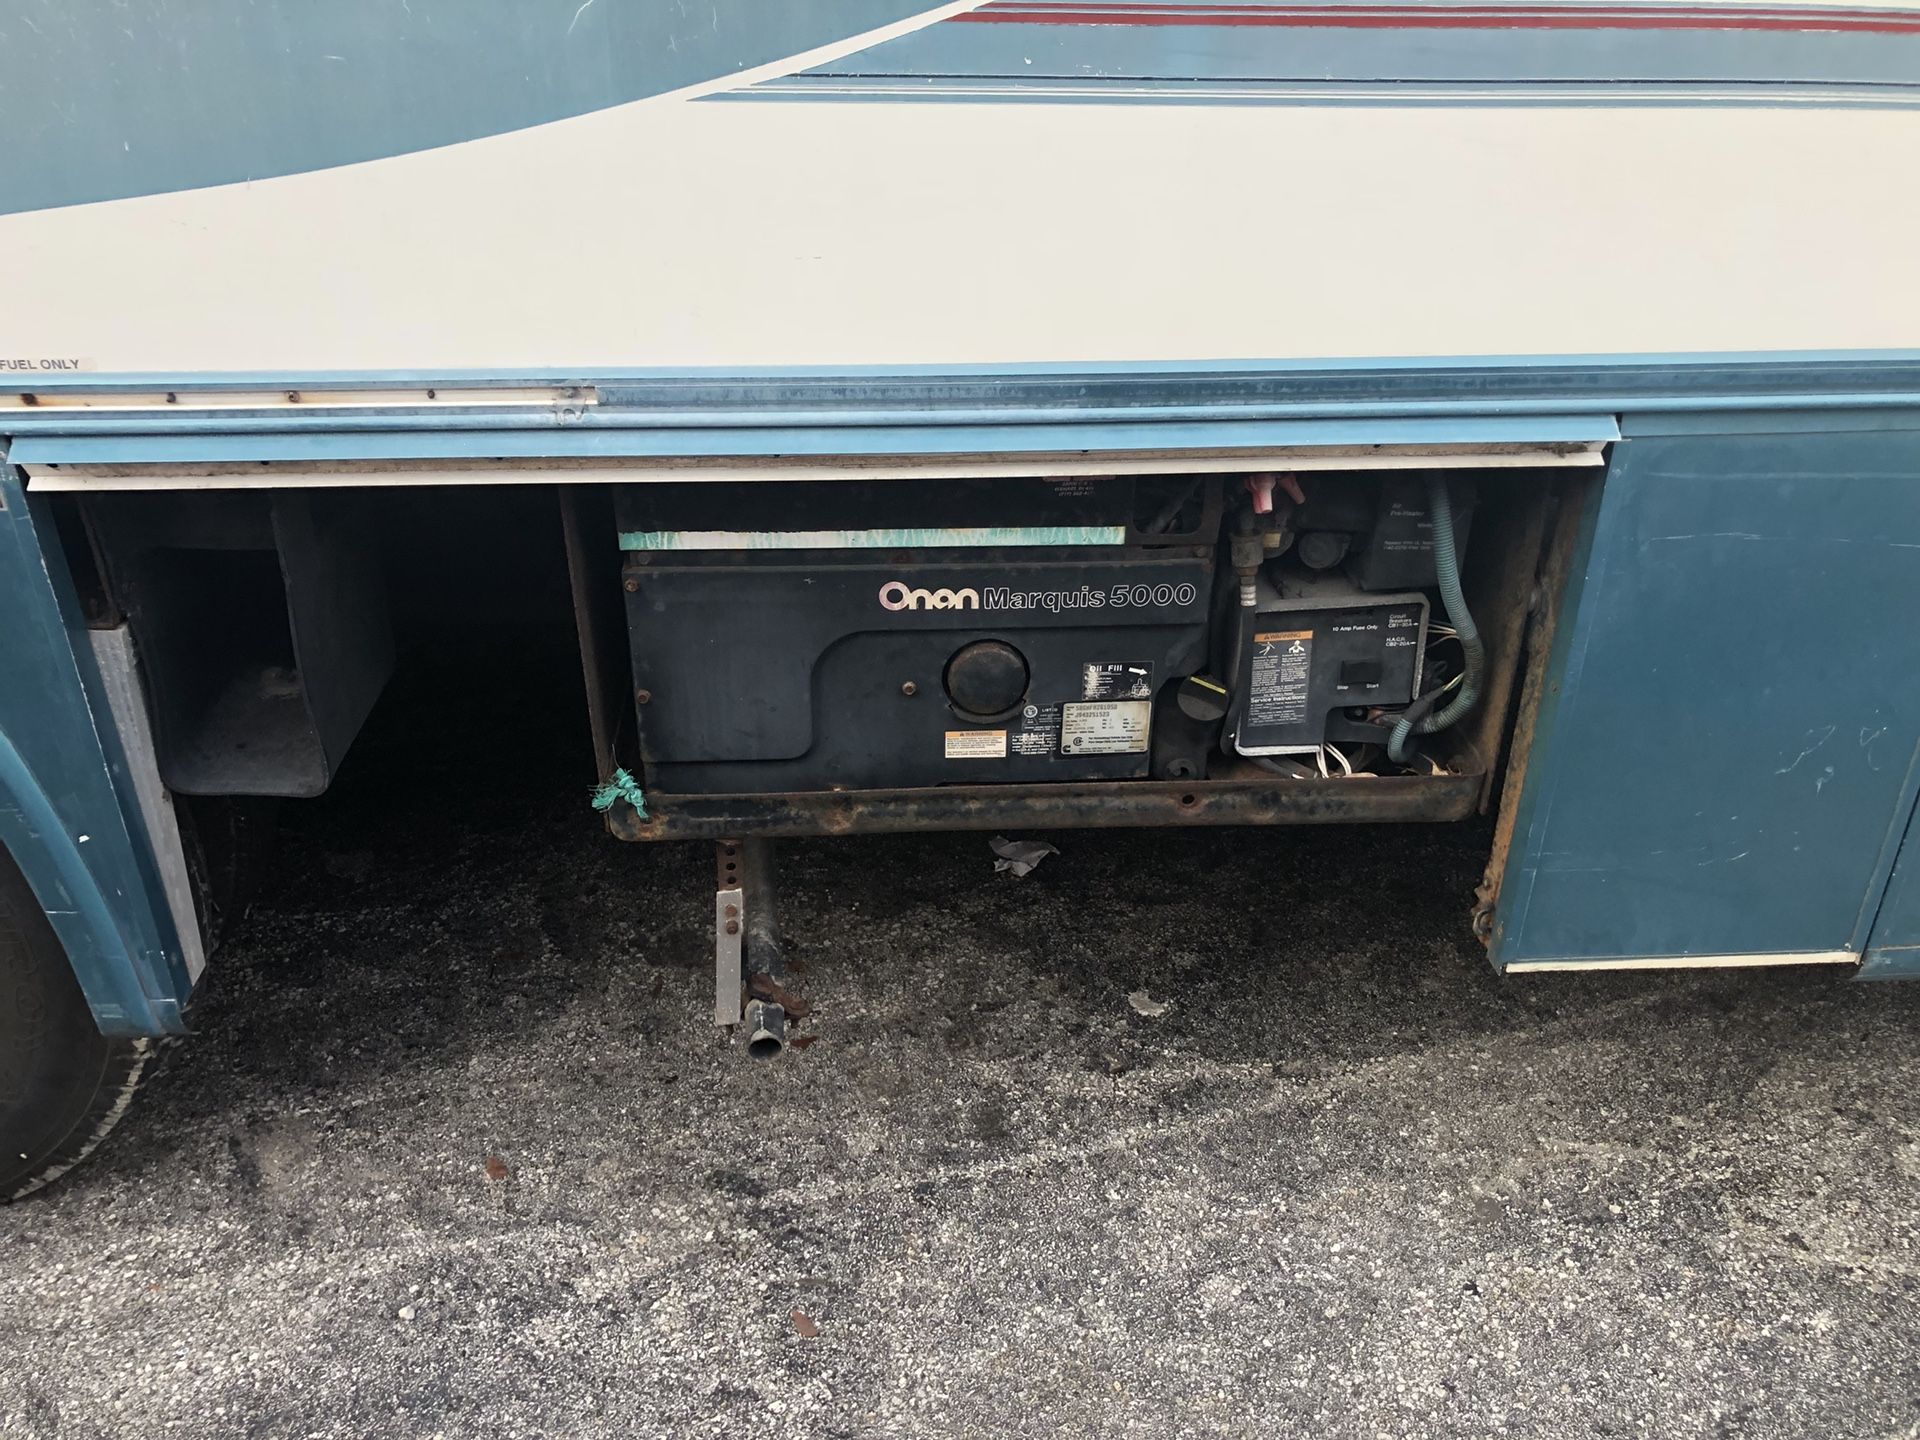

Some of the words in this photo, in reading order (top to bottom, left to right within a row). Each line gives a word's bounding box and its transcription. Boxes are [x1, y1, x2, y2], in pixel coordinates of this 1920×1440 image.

[0, 359, 38, 370] FUEL
[39, 359, 79, 370] ONLY
[878, 581, 980, 611] Onan
[983, 586, 1105, 613] Marquis
[1109, 583, 1196, 607] 5000
[1089, 665, 1102, 673] Oil
[1108, 664, 1123, 672] Fill
